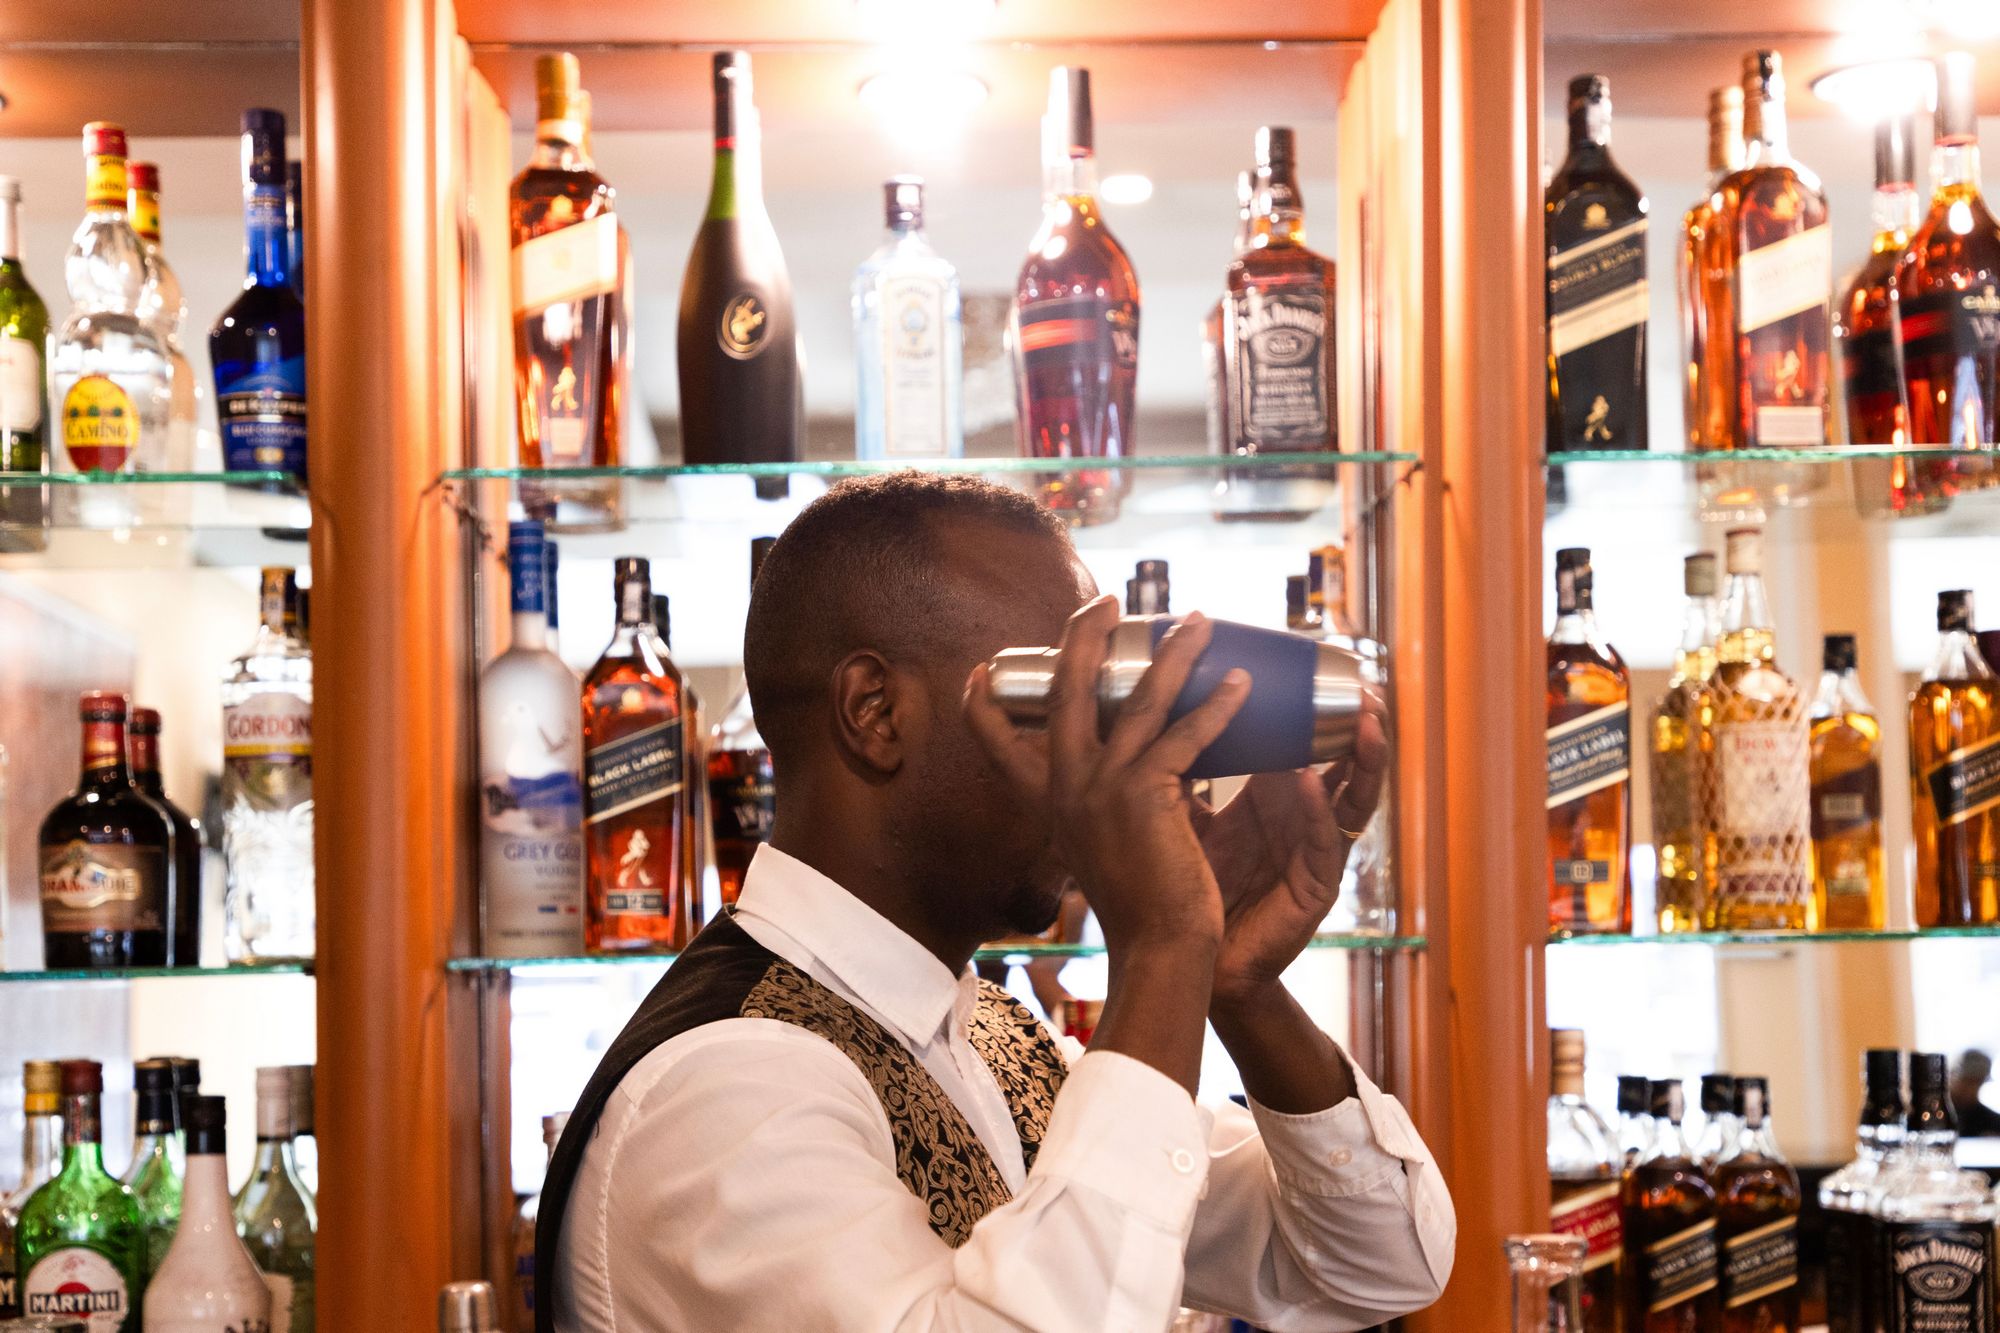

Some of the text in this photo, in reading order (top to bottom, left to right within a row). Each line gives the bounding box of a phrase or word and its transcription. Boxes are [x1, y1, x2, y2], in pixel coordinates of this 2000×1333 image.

[1581, 729, 1625, 757] LABEL
[588, 762, 630, 788] BLACK
[631, 748, 676, 772] LABEL
[504, 843, 549, 861] GREY
[32, 1291, 119, 1313] MARTINI
